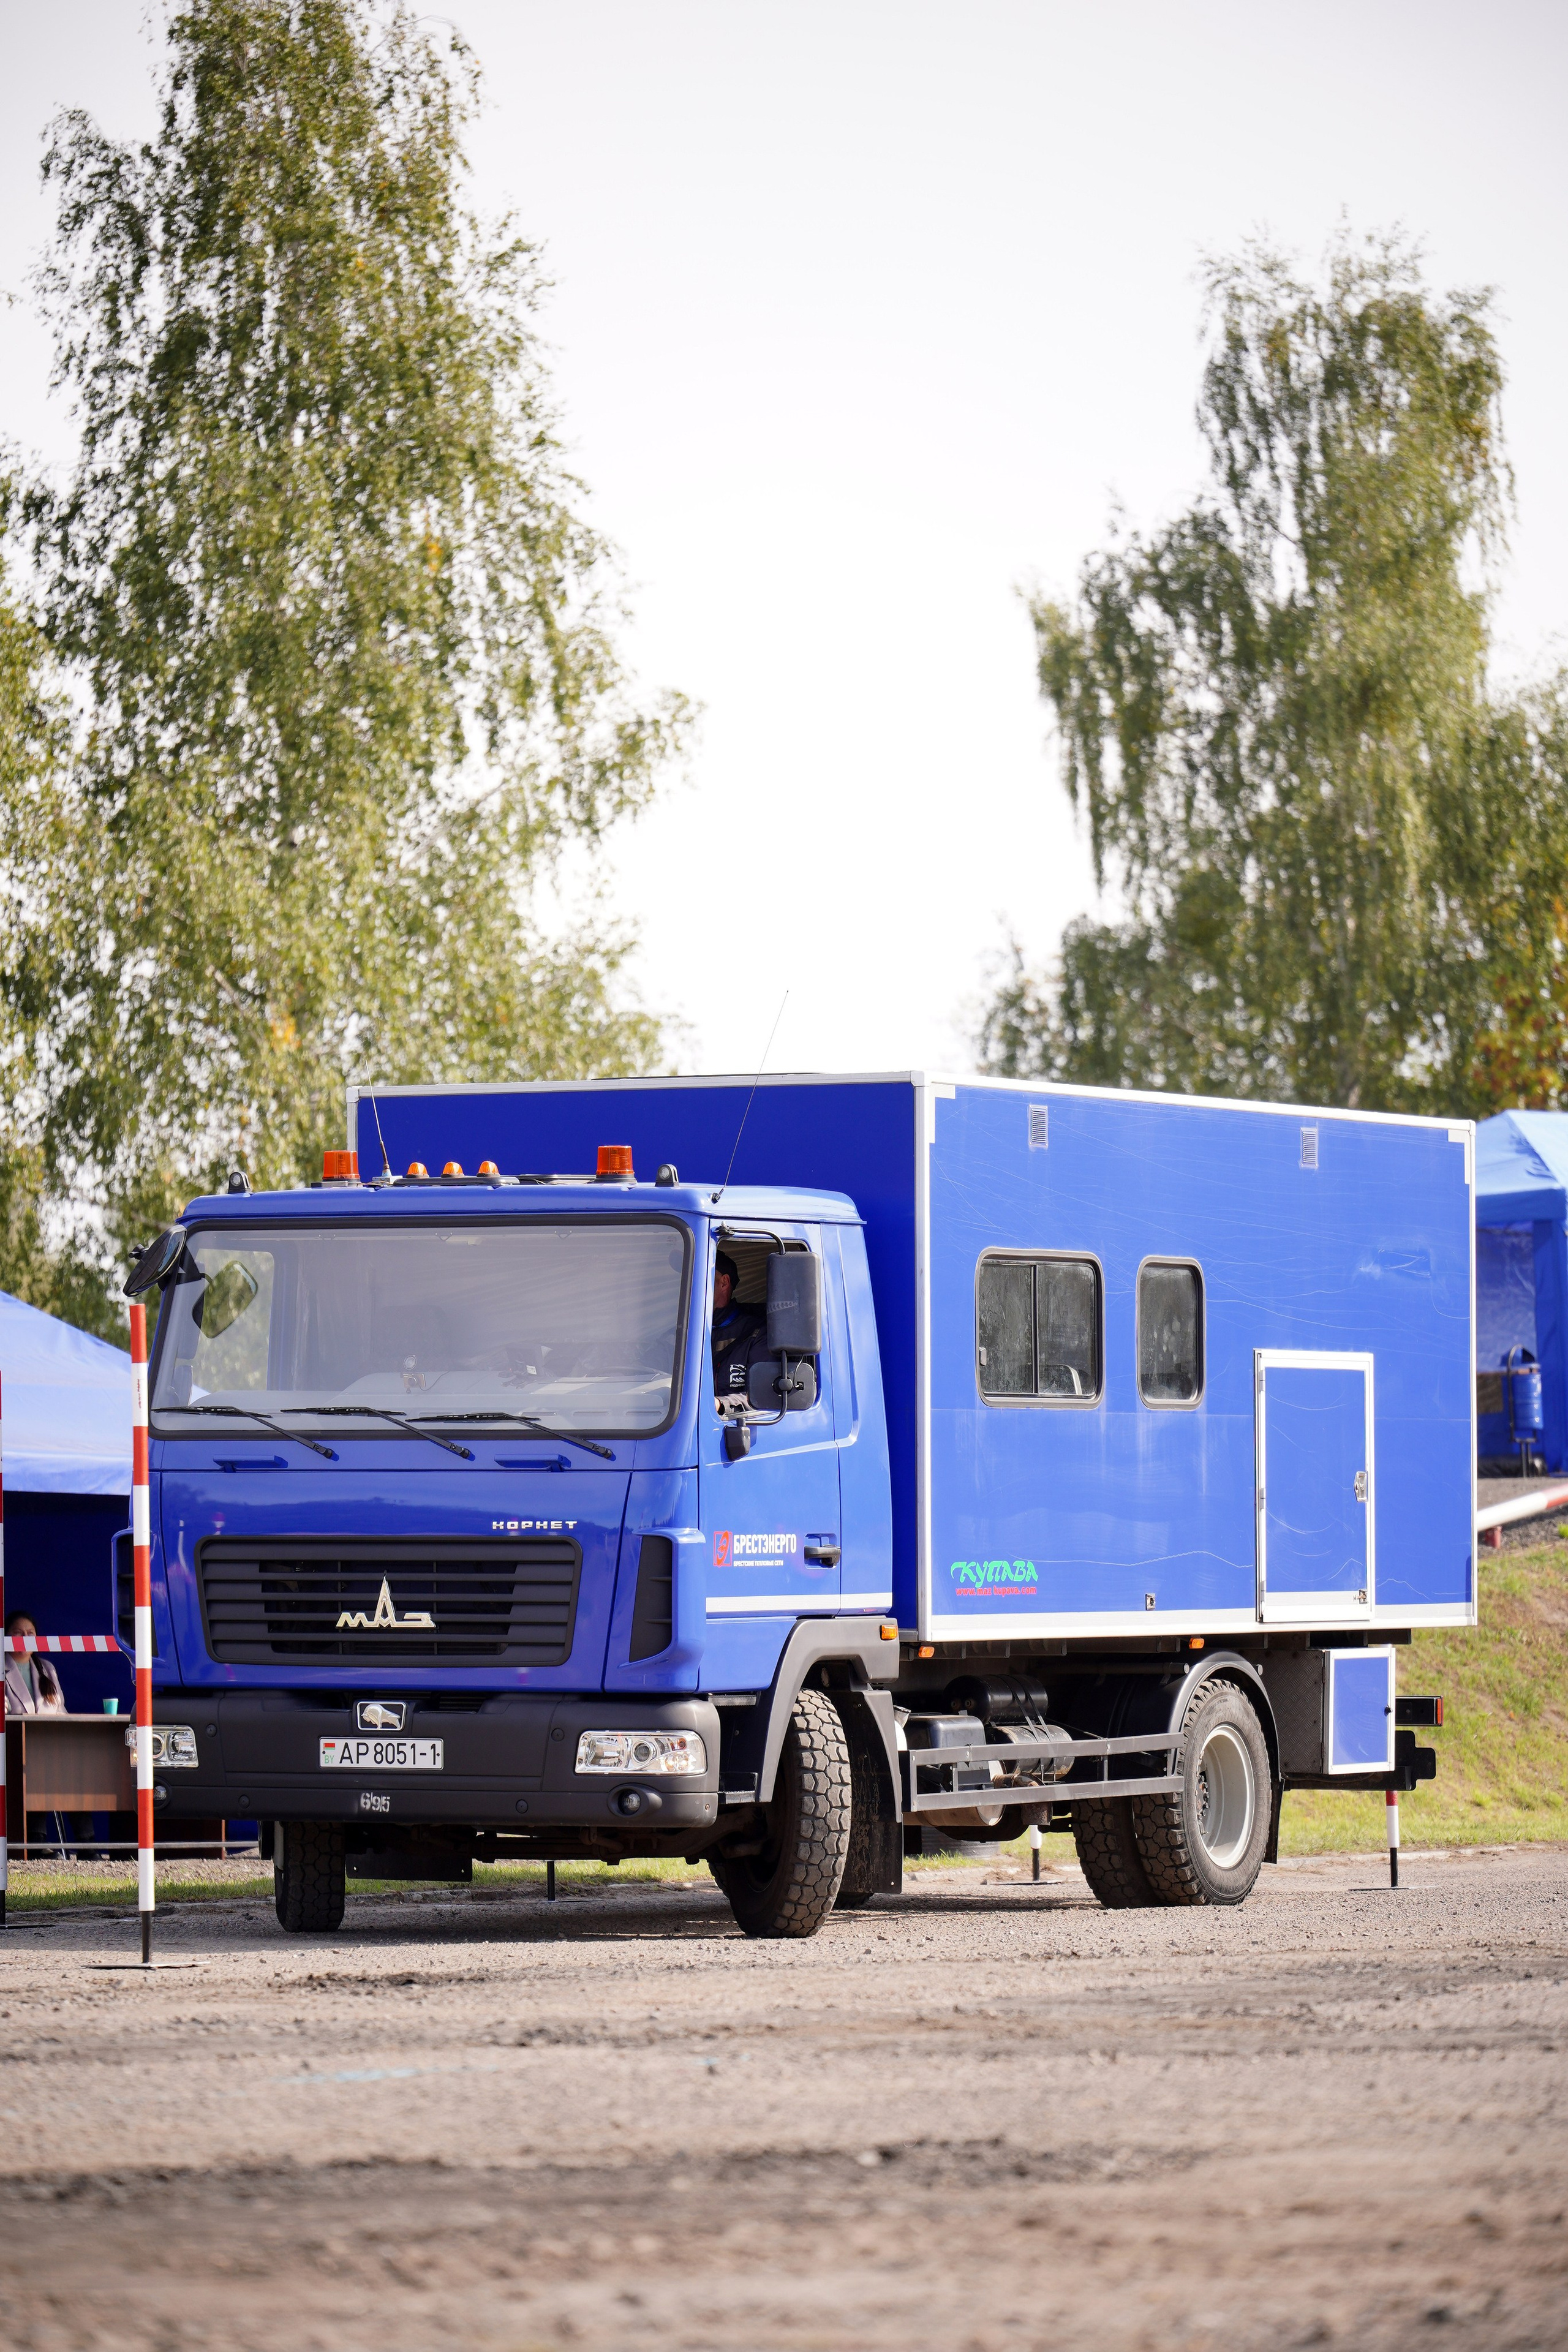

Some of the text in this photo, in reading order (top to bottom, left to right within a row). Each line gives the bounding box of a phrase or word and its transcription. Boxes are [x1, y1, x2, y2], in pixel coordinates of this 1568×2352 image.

[492, 1521, 578, 1529] КОРНЕТ
[733, 1534, 796, 1554] БРЕСТЭНЕРГО
[951, 1560, 1039, 1588] КУПАВА
[336, 1576, 436, 1628] МАЗ
[325, 1755, 334, 1764] BY
